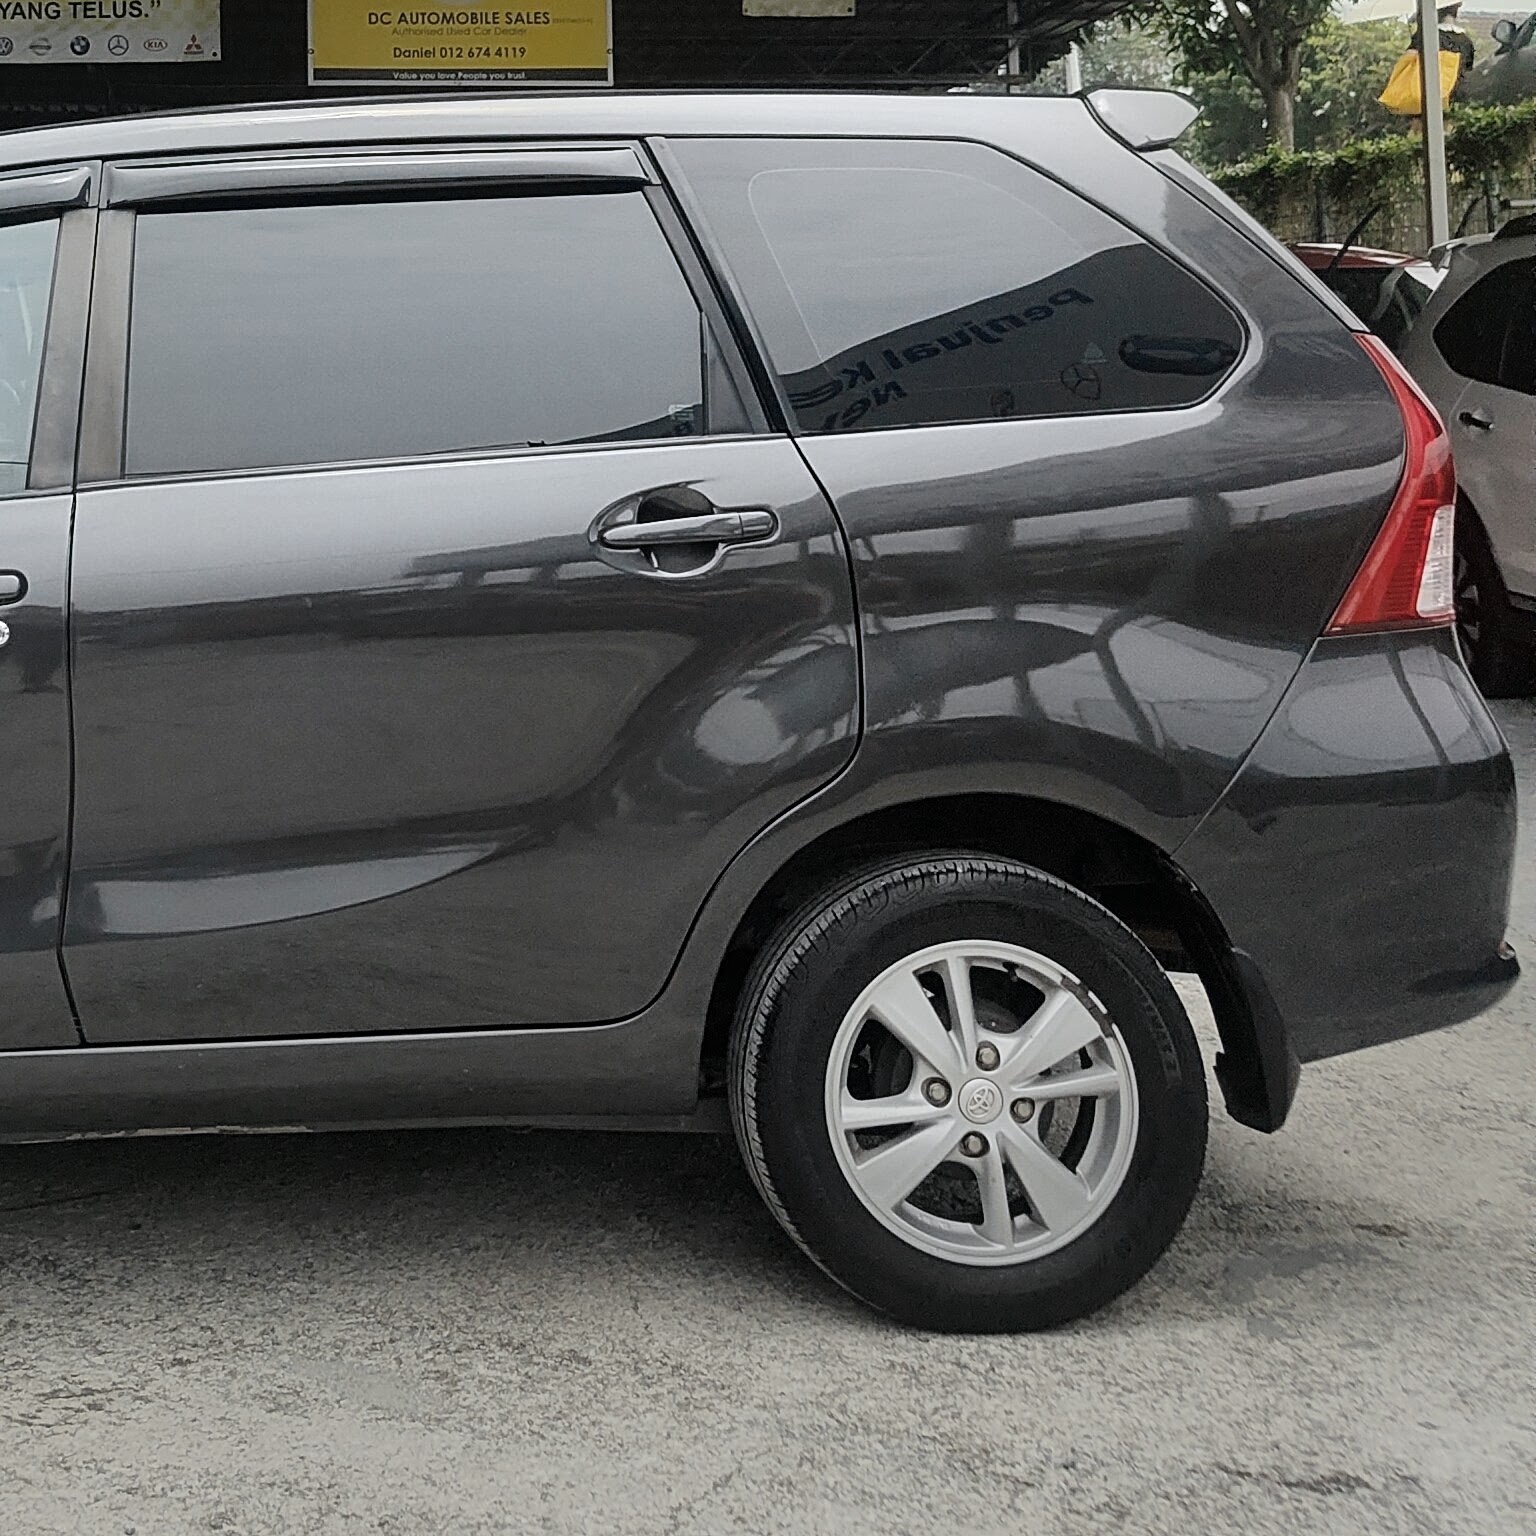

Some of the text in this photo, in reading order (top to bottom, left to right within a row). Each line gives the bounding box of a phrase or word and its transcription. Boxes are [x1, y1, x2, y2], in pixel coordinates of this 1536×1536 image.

[368, 12, 392, 24] DC
[397, 12, 500, 25] AUTOMOBILE
[505, 11, 550, 25] SALES
[392, 27, 527, 36] Authorised Used Car Dealer
[393, 47, 526, 58] Daniel 012 674 4119
[393, 72, 418, 80] Value
[420, 73, 435, 81] you
[489, 73, 505, 81] you
